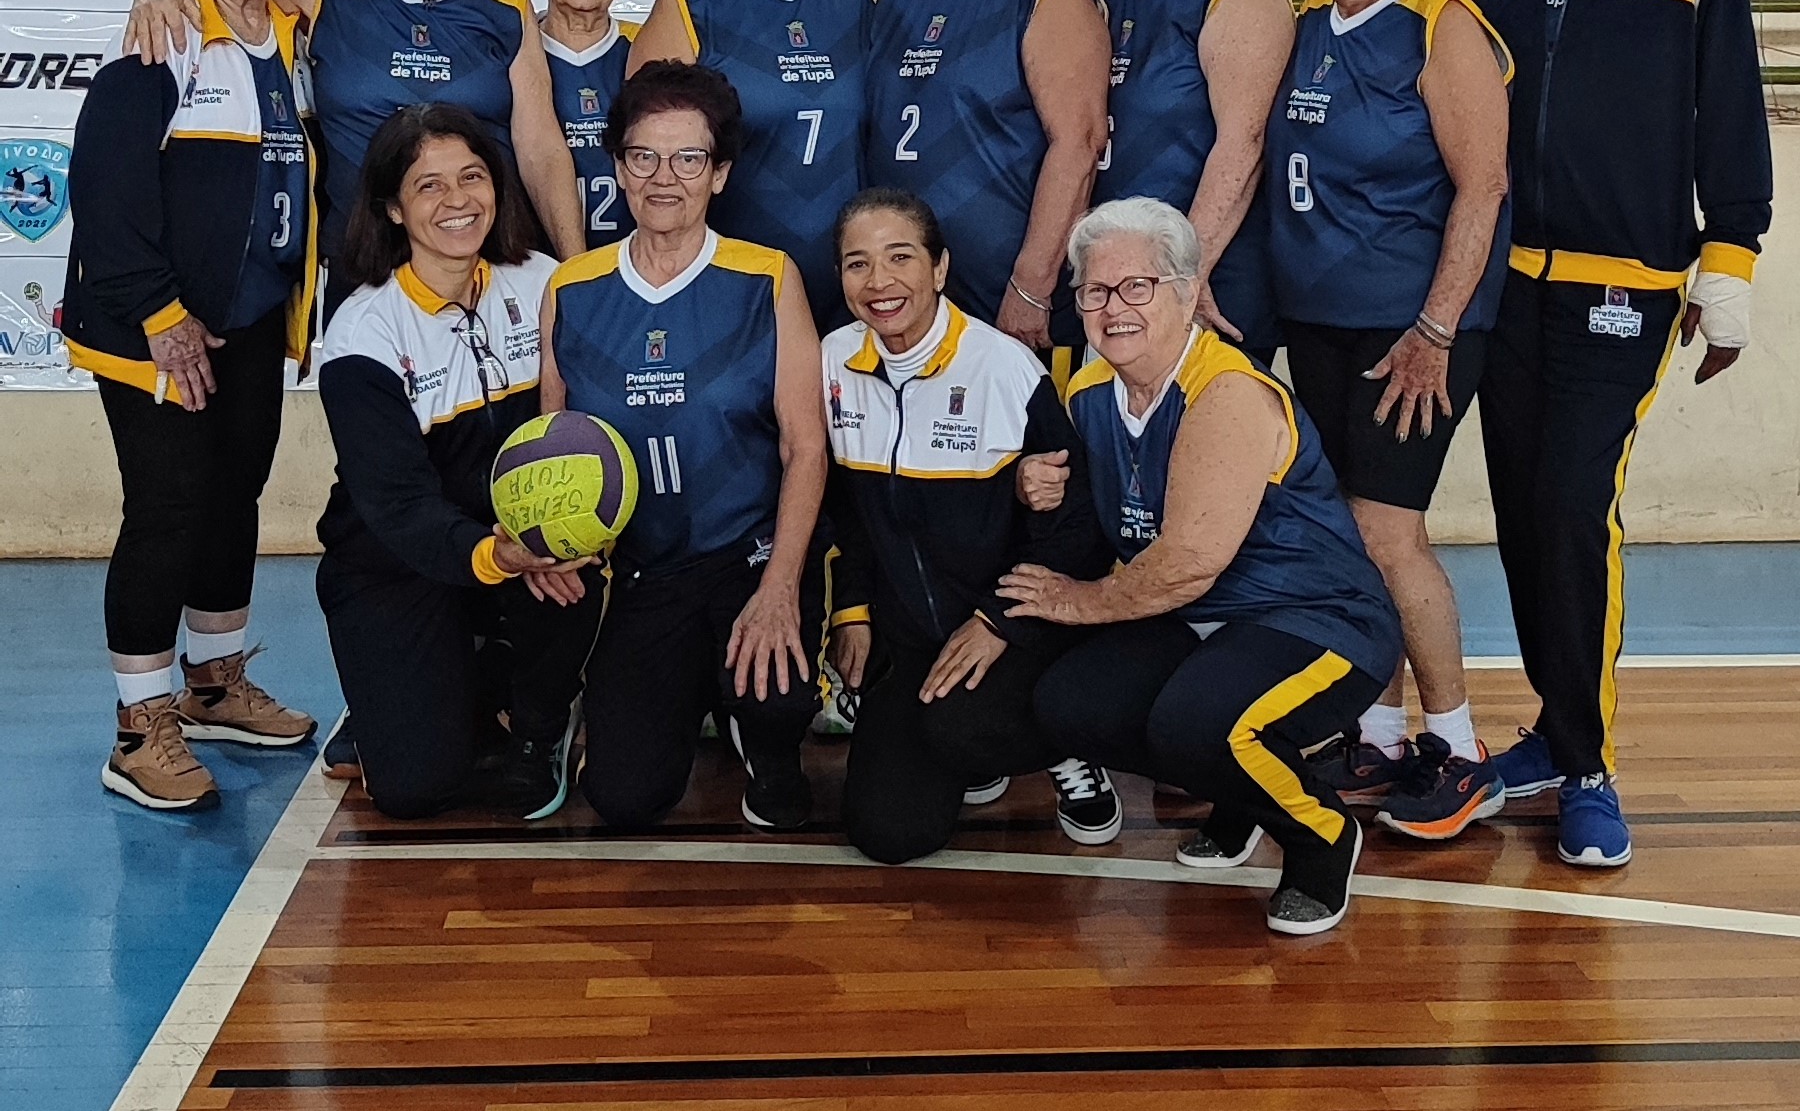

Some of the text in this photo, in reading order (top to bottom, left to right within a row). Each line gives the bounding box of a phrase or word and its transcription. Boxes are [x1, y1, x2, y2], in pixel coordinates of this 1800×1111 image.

[392, 51, 451, 63] Prefeitura
[777, 54, 830, 65] Prefeitura
[903, 48, 943, 59] Prefeitura
[390, 65, 411, 78] de
[412, 67, 451, 82] Tupã
[781, 69, 835, 83] de Tupã
[899, 63, 937, 79] de Tupã
[1286, 107, 1326, 125] de Tupã
[565, 120, 609, 131] Prefeitu
[895, 104, 921, 161] 2
[567, 137, 602, 148] de Tu
[797, 109, 824, 165] 7
[263, 147, 305, 165] de Tupã
[1288, 152, 1314, 212] 8
[577, 175, 618, 231] 12
[18, 219, 48, 228] 2025
[270, 191, 291, 248] 3
[1591, 308, 1640, 320] Prefeitura
[1590, 321, 1607, 331] de
[1608, 322, 1639, 335] Tupã
[626, 371, 685, 384] Prefeitura
[626, 388, 686, 407] de Tupã
[932, 420, 978, 433] Prefeitura
[931, 438, 977, 453] de Tupã
[647, 435, 682, 495] 11
